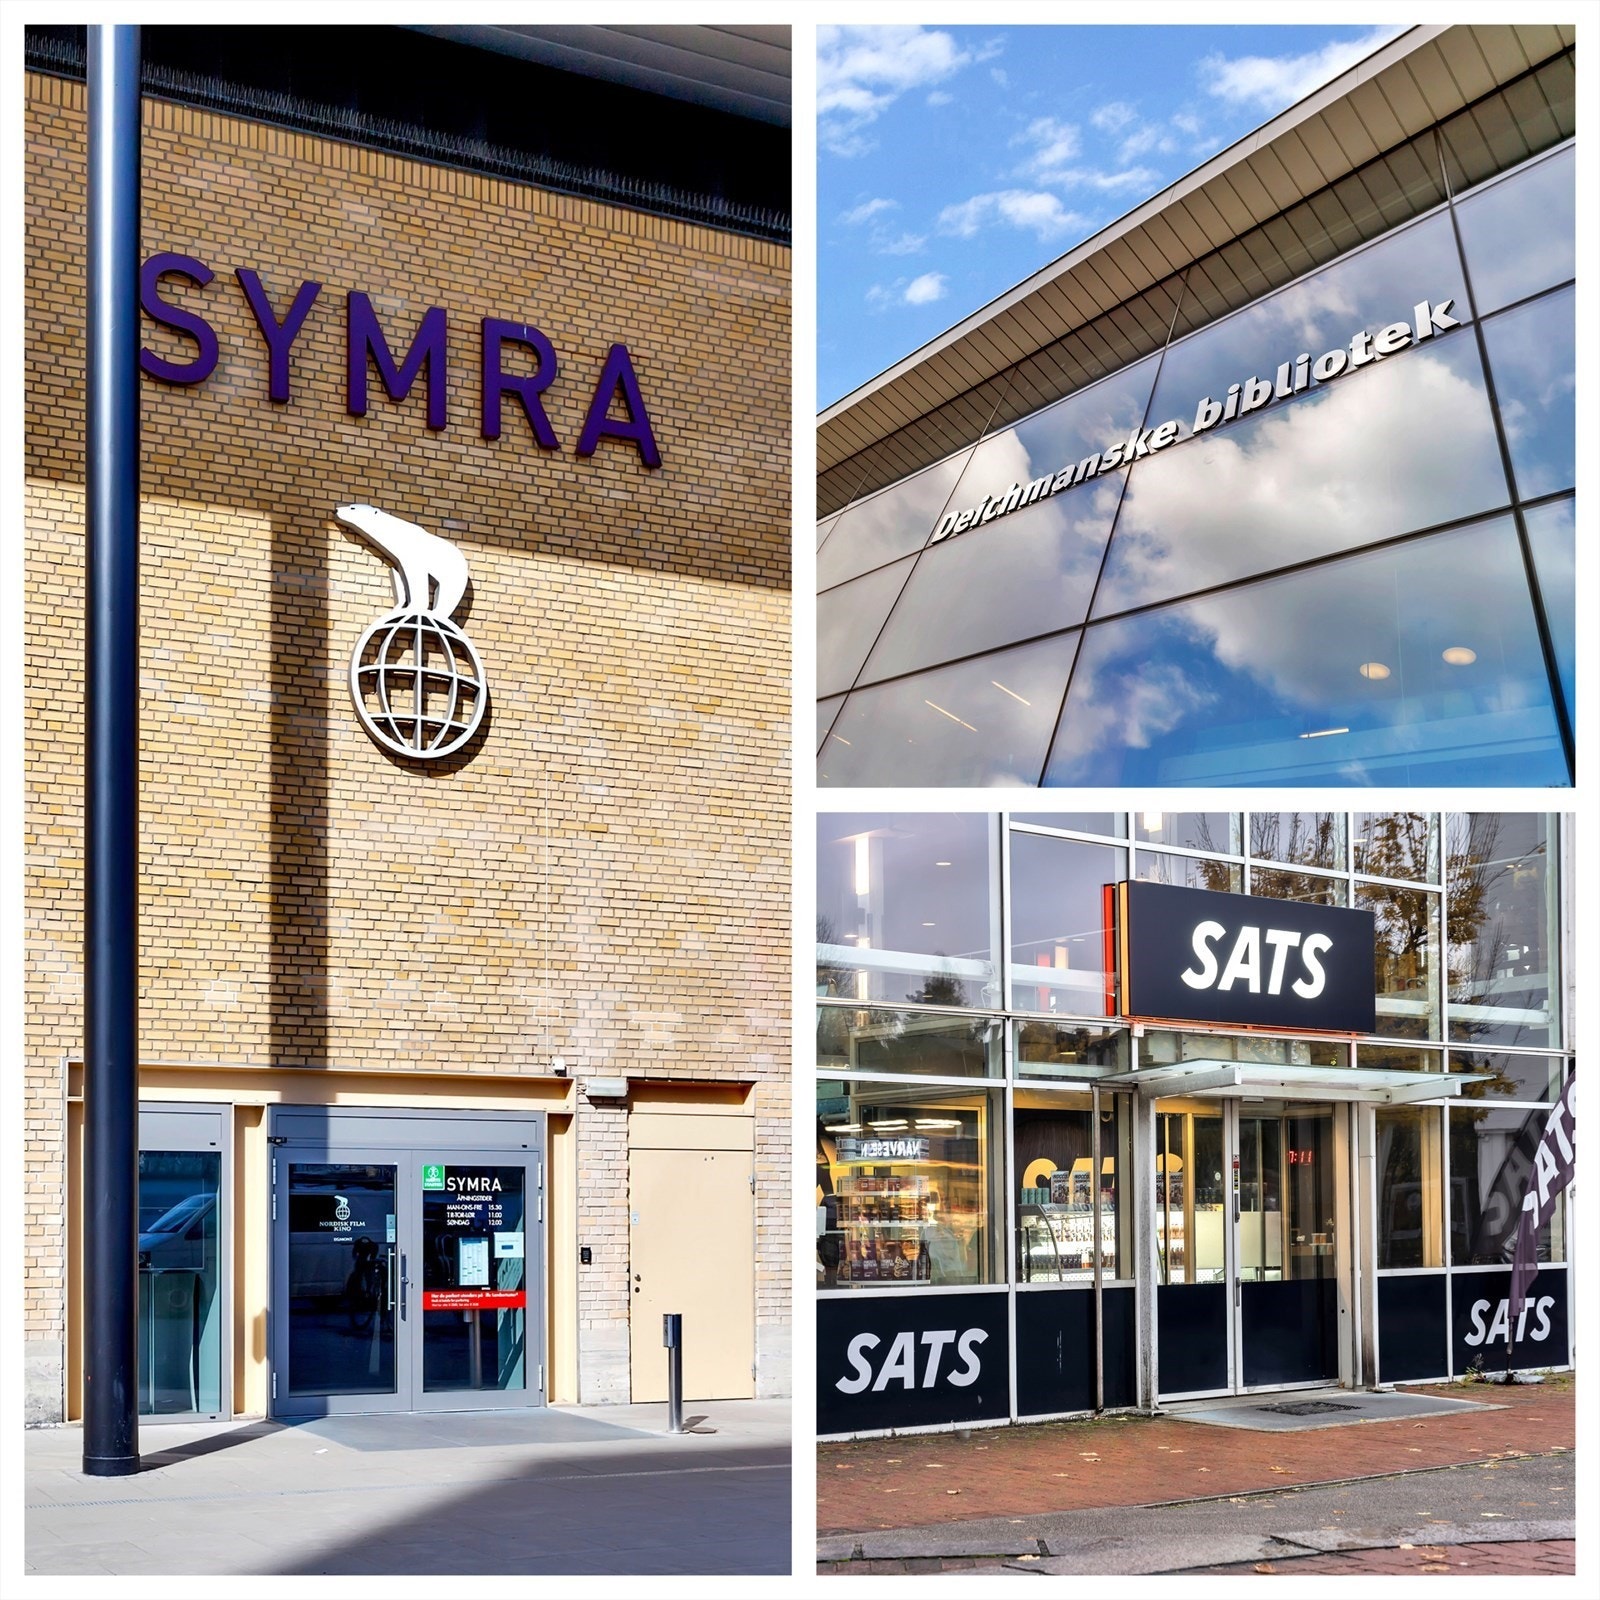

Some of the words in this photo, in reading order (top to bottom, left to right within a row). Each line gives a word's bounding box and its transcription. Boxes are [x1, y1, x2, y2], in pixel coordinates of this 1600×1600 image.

[139, 251, 662, 471] SYMRA
[931, 419, 1180, 545] Deichmanske
[1192, 299, 1462, 435] bibliotek
[1180, 920, 1334, 999] SATS
[447, 1177, 502, 1191] SYMRA
[1464, 1295, 1555, 1346] SATS
[835, 1328, 989, 1395] SATS
